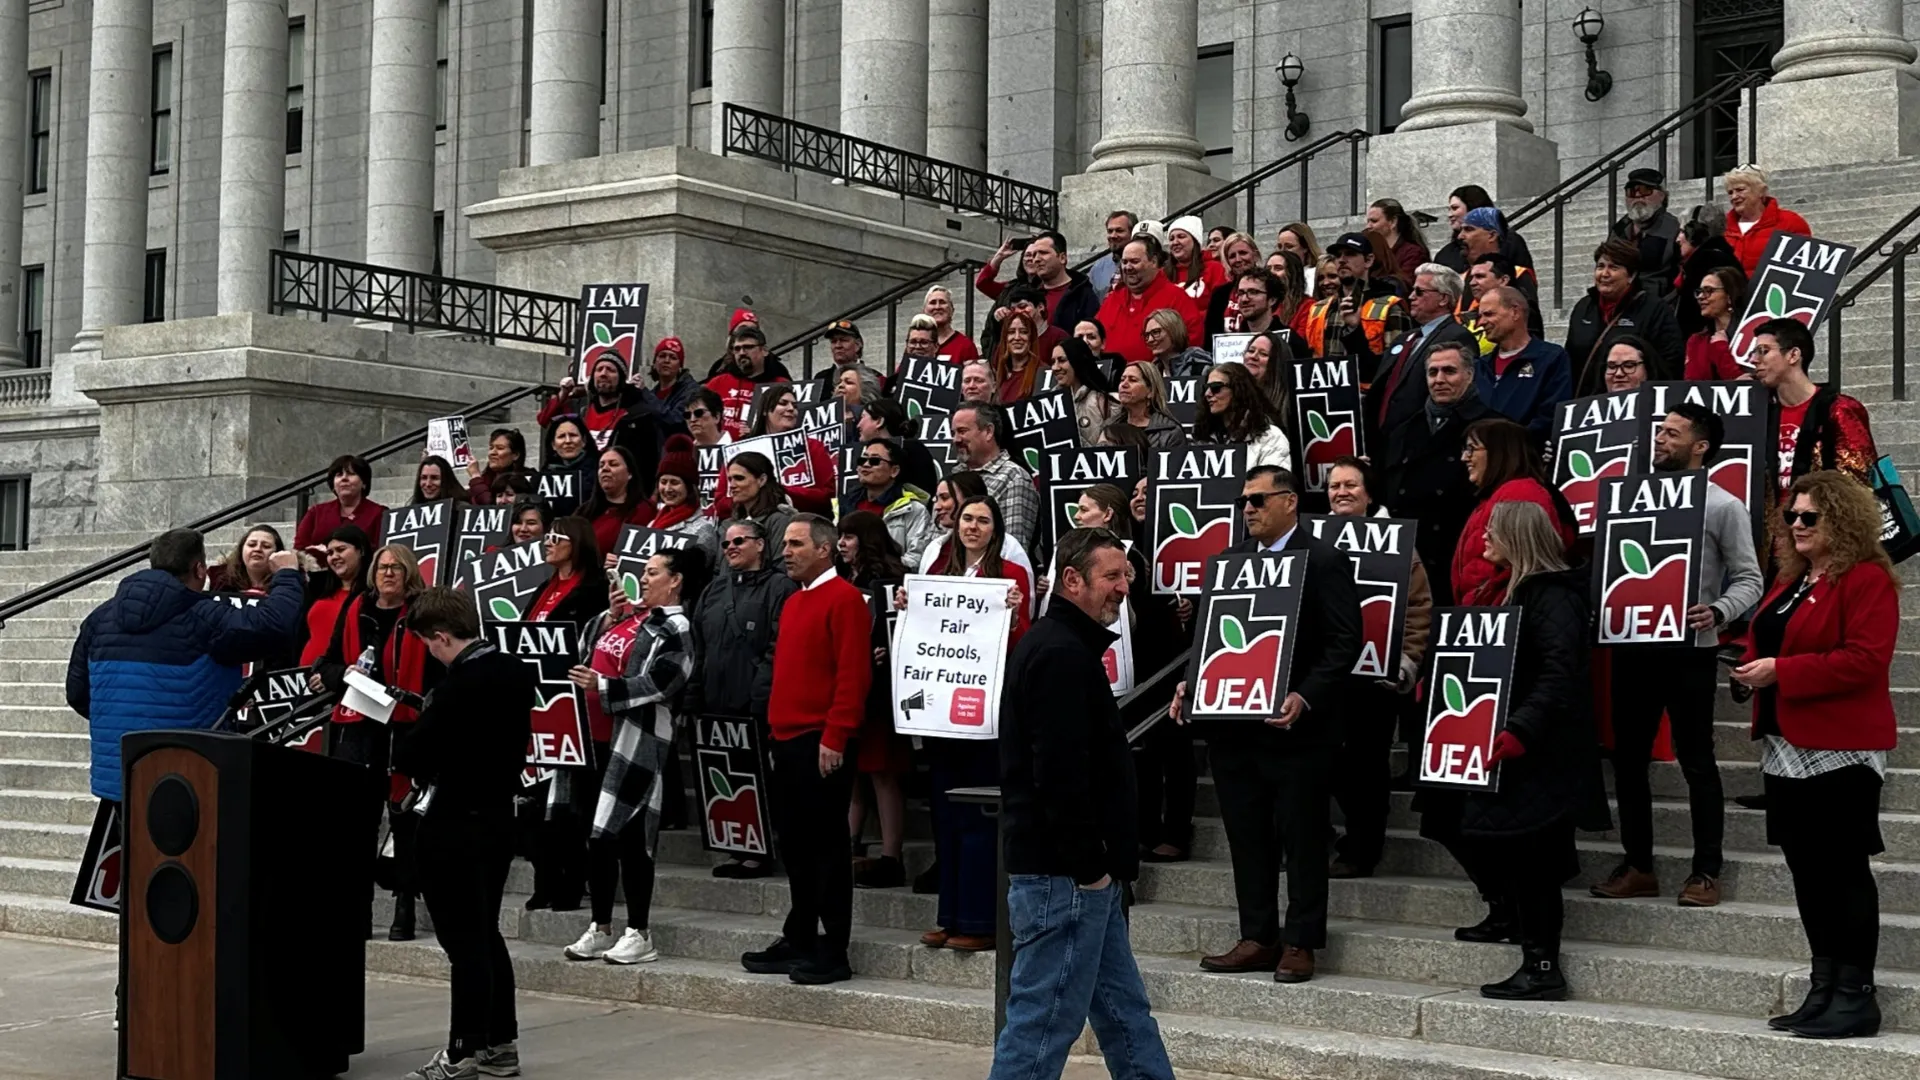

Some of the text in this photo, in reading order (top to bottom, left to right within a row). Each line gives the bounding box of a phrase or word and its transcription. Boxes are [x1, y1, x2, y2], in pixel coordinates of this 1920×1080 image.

[1772, 235, 1846, 275] I AM
[586, 287, 641, 308] I AM
[905, 357, 958, 390] I AM
[1041, 369, 1053, 391] I
[1294, 360, 1350, 390] I AM
[792, 383, 815, 403] M
[1167, 380, 1198, 403] M
[1652, 386, 1752, 416] I AM
[801, 401, 838, 431] AM
[1006, 393, 1068, 430] I AM
[1561, 392, 1639, 431] I AM
[774, 433, 803, 450] I AM
[918, 417, 954, 440] I A
[698, 448, 720, 471] M
[844, 448, 854, 473] I
[1049, 450, 1129, 481] I AM
[1157, 449, 1236, 481] I AM
[537, 474, 573, 498] AM
[782, 472, 809, 486] UEA
[1608, 475, 1694, 514] I AM
[387, 503, 442, 534] I AM
[461, 509, 506, 532] I AM
[622, 528, 688, 556] I AM
[1334, 521, 1403, 555] AM
[470, 540, 545, 585] I AM
[1157, 562, 1201, 592] UE
[1212, 556, 1296, 591] I AM
[883, 584, 896, 613] I
[925, 593, 989, 613] Fair Pay,
[940, 619, 970, 634] Fair
[1436, 612, 1509, 647] I AM
[1605, 604, 1680, 640] UEA
[495, 626, 510, 654] I
[516, 627, 570, 655] AM
[916, 642, 981, 663] Schools,
[269, 673, 313, 700] AM
[904, 665, 987, 686] Fair Future
[1200, 678, 1271, 711] UEA
[696, 719, 751, 750] I AM
[1425, 743, 1485, 781] UEA
[710, 819, 762, 850] UEA
